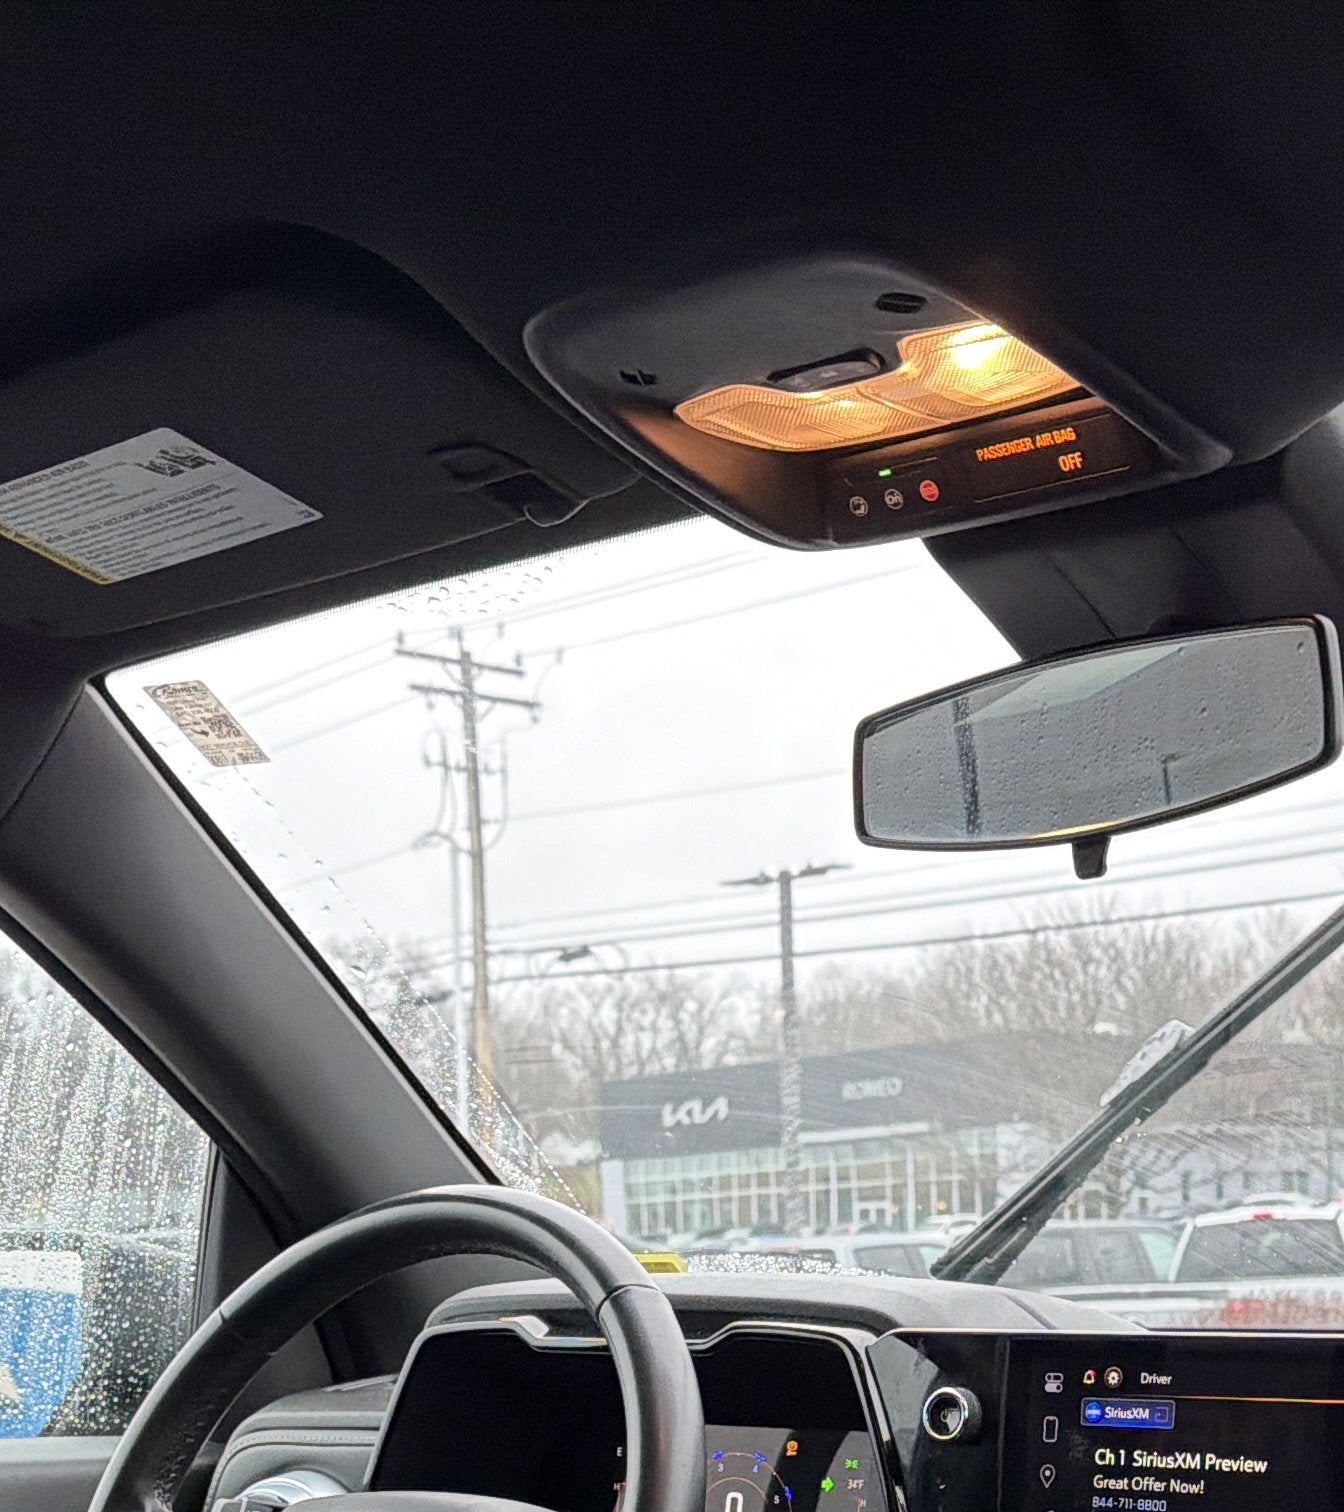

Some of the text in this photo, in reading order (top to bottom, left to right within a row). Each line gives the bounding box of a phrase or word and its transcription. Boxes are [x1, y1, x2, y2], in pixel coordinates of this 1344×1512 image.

[976, 437, 1035, 462] PASSENGER
[1058, 452, 1083, 472] OFF
[1140, 1372, 1172, 1386] Driver
[1104, 1406, 1150, 1420] SiriusXM
[1094, 1449, 1268, 1474] Ch 1 SiriusXM Preview
[1093, 1475, 1205, 1495] Great Offer Now!
